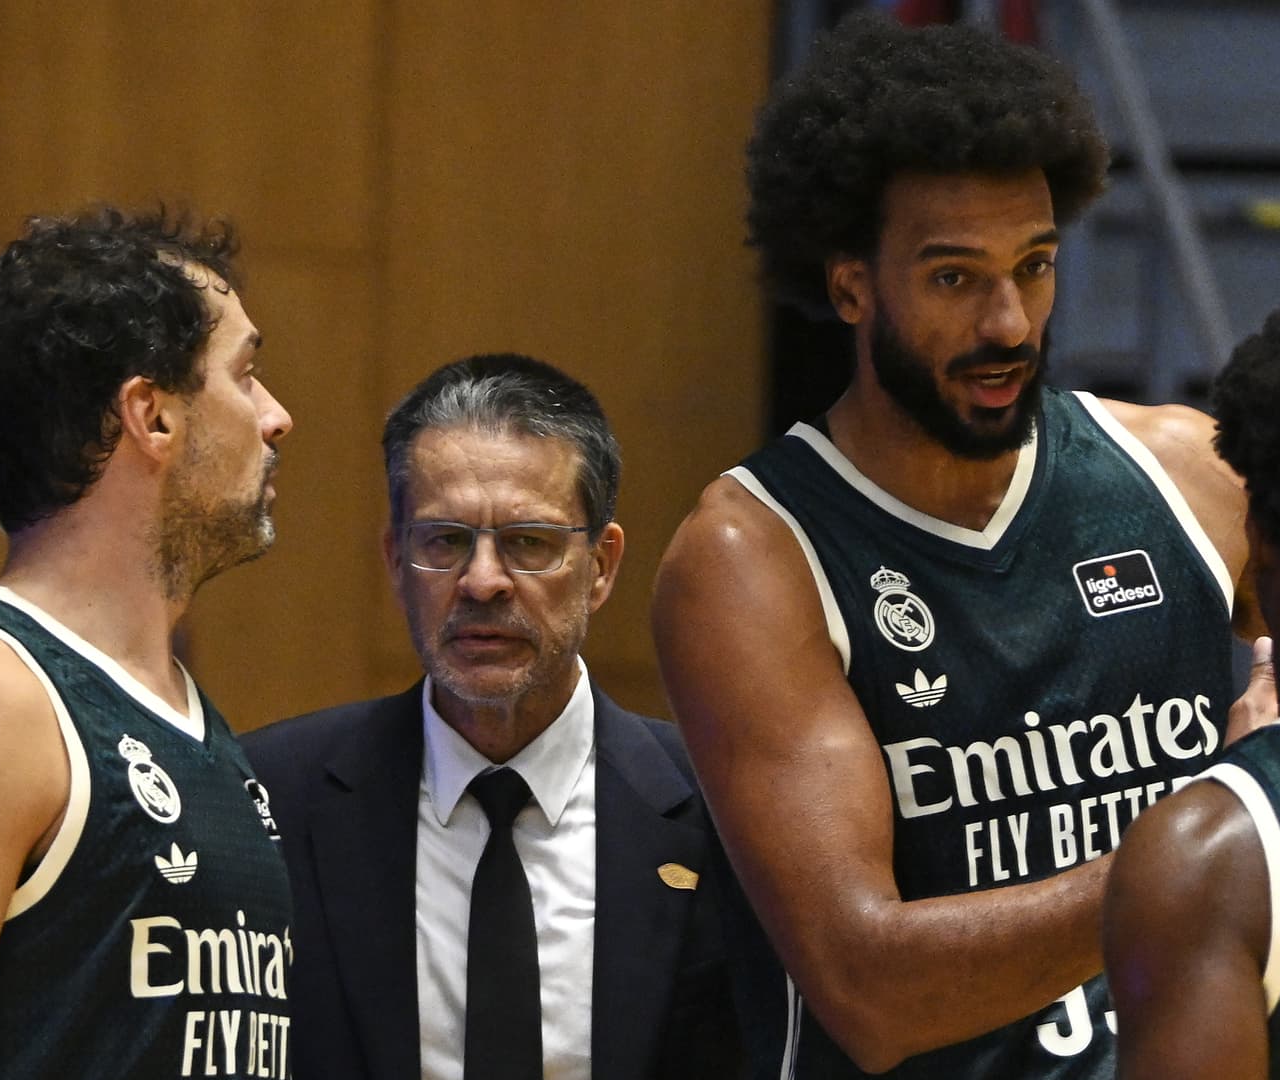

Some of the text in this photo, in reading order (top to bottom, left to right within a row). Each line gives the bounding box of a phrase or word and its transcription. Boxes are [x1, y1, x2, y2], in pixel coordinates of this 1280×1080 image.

[1086, 576, 1119, 594] liga
[1092, 584, 1157, 608] endesa
[882, 692, 1220, 820] Emirates
[965, 811, 1030, 887] FLY
[129, 909, 293, 1000] Emira
[181, 1009, 241, 1077] FLY
